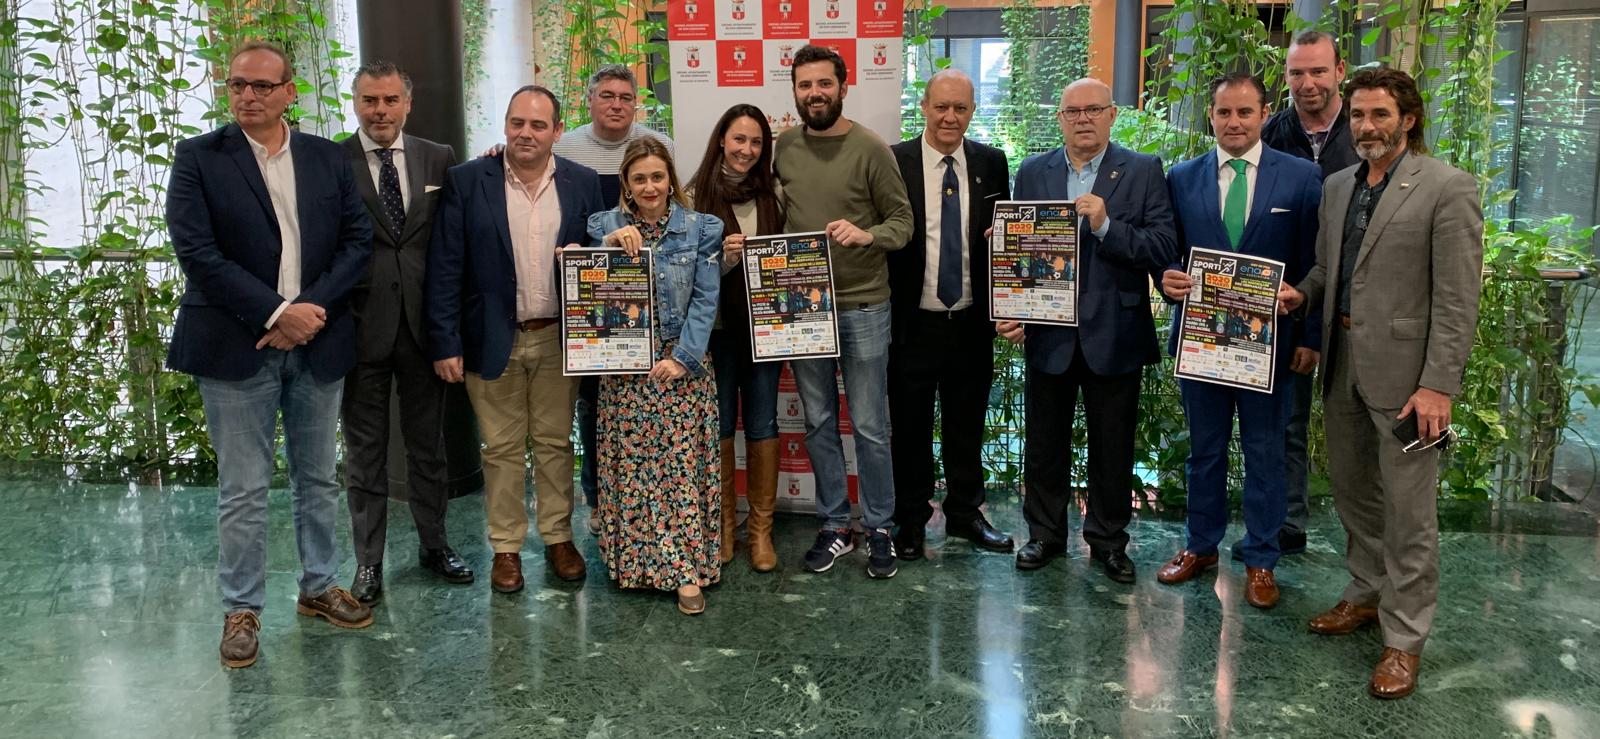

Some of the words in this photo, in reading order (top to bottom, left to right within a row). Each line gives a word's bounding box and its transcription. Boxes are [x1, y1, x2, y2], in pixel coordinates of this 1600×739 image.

[747, 247, 775, 256] SPORTI
[1193, 261, 1221, 271] SPORTI
[1206, 274, 1230, 284] 2020
